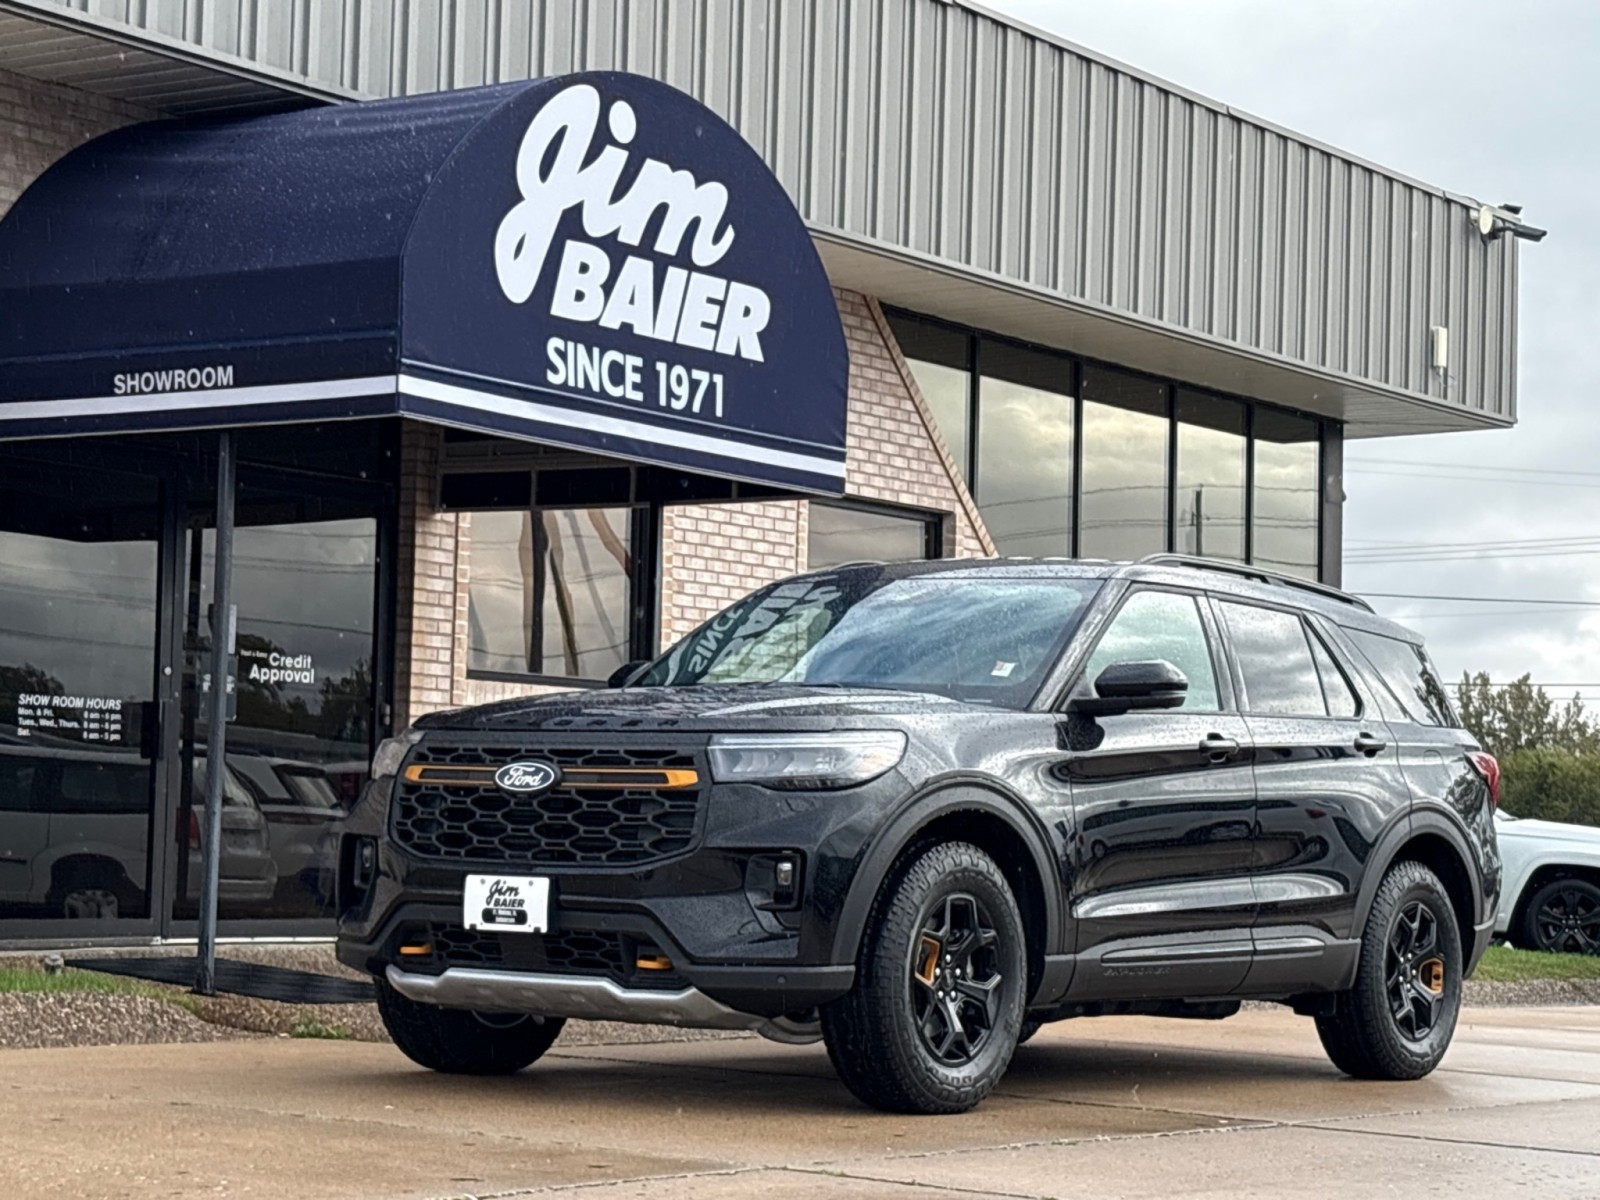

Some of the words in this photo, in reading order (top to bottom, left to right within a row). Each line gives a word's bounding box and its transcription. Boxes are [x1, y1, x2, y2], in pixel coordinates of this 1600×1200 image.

[494, 83, 735, 304] Jim
[550, 240, 771, 363] BAIER
[113, 365, 234, 394] SHOWROOM
[546, 336, 644, 402] SINCE
[655, 361, 723, 418] 1971
[269, 652, 312, 669] Credit
[249, 663, 315, 684] Approval
[18, 693, 51, 706] SHOW
[52, 695, 84, 708] ROOM
[85, 697, 122, 710] HOURS
[504, 765, 544, 786] Ford
[486, 879, 520, 906] Jim
[493, 898, 525, 908] BAIER
